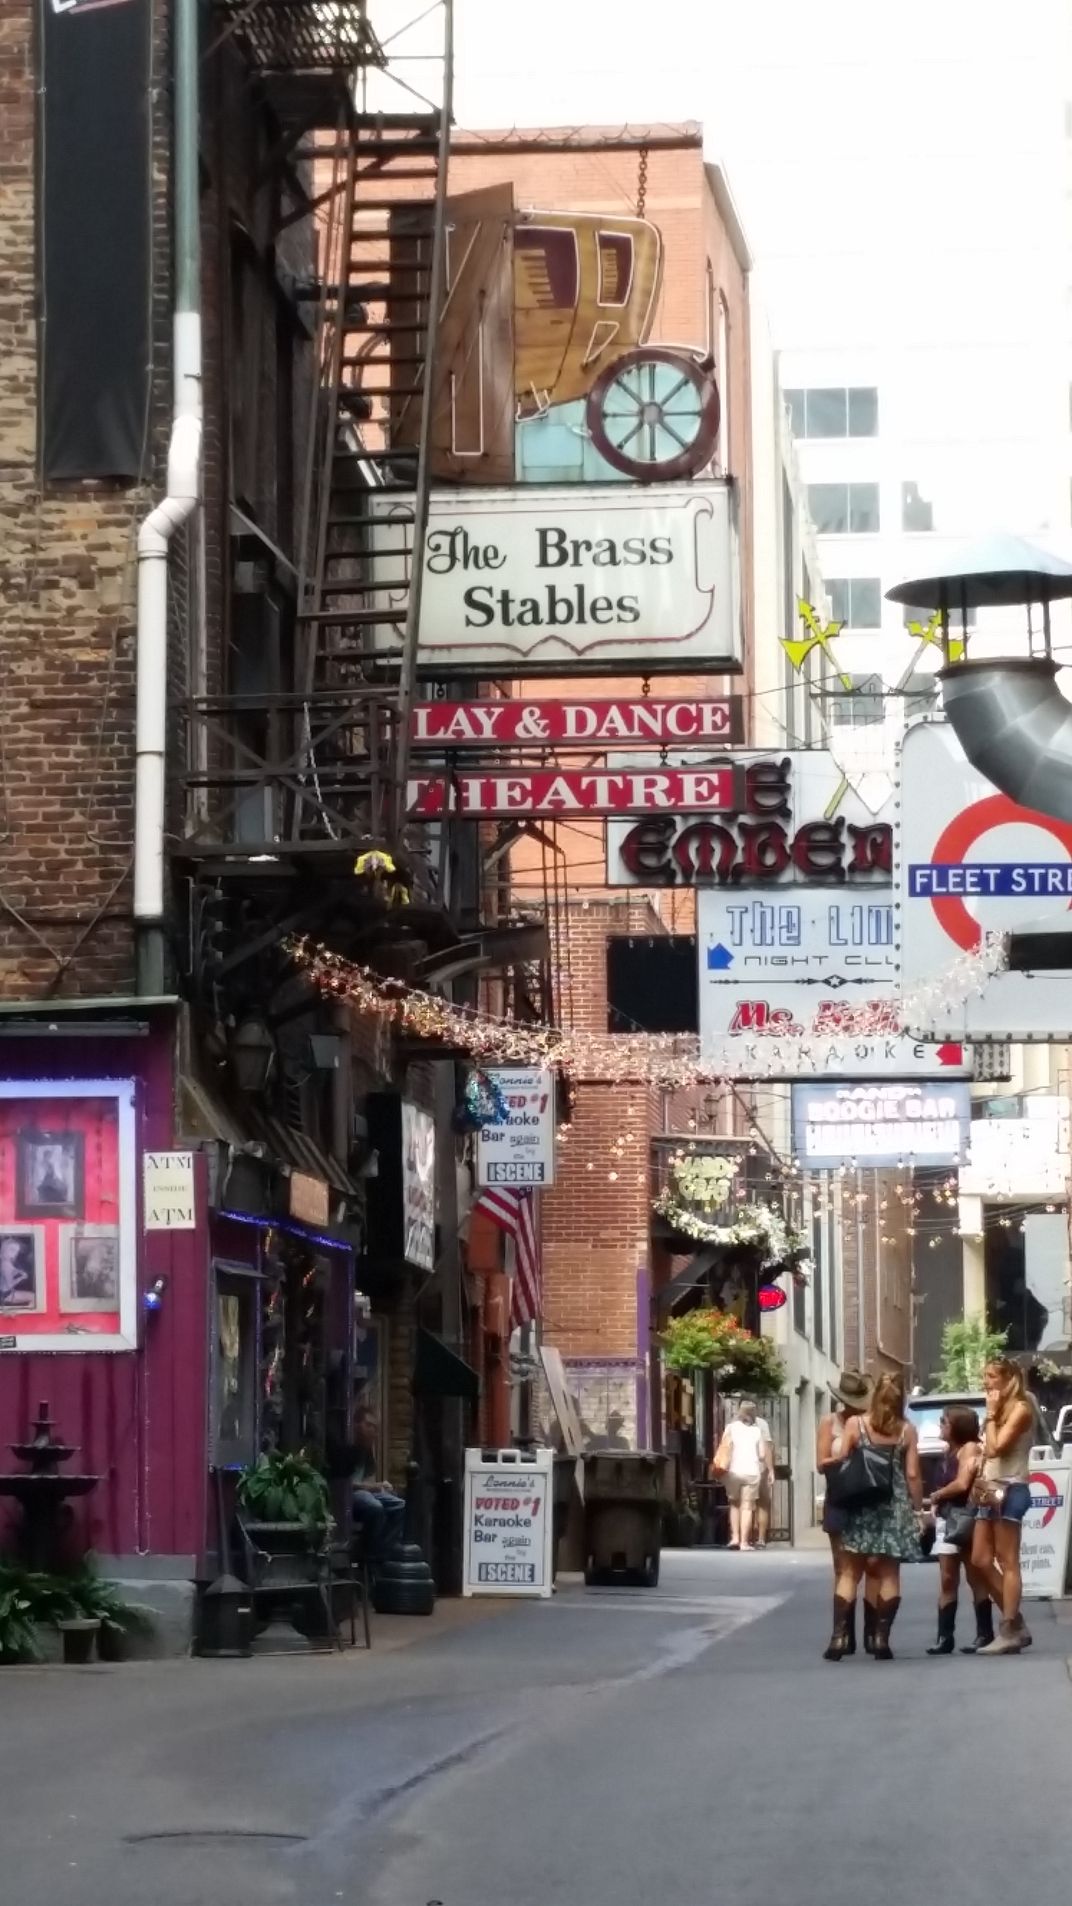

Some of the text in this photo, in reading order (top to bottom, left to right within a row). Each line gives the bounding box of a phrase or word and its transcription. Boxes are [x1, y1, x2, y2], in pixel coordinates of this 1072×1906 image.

[427, 526, 674, 574] The Brass
[463, 584, 641, 628] Stables
[514, 706, 551, 738] &
[562, 703, 731, 738] DANCE
[406, 773, 720, 812] THEATRE
[915, 868, 1072, 892] FLEET STR
[744, 955, 829, 966] NIGHT
[481, 1129, 505, 1142] Bar
[147, 1155, 191, 1169] ATM
[496, 1163, 542, 1181] SCENE
[149, 1208, 192, 1221] ATM
[475, 1496, 521, 1510] VOTED
[474, 1513, 532, 1527] Karaoke
[474, 1529, 498, 1542] Bar
[487, 1564, 532, 1582] SCENE
